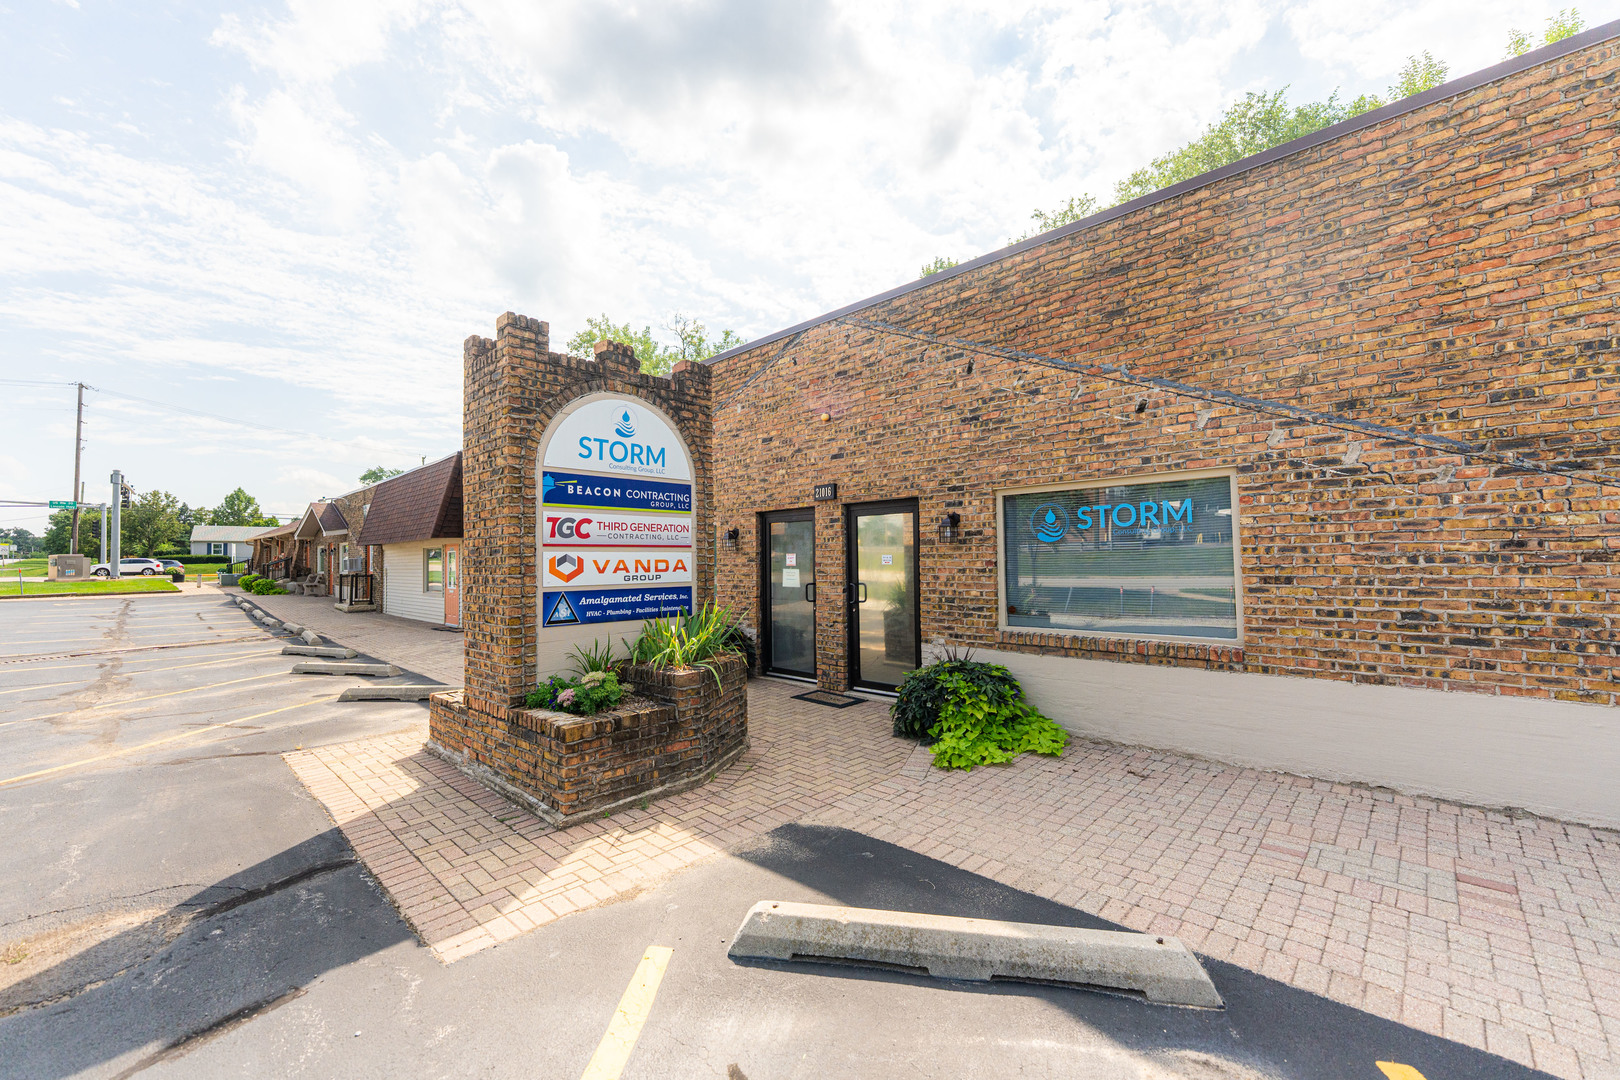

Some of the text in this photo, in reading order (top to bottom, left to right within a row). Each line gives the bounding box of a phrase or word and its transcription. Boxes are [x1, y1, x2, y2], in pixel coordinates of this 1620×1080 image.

[578, 436, 665, 467] STORM
[609, 462, 637, 473] Consulting
[568, 485, 690, 502] BEACON CONTRACTING
[815, 486, 832, 498] 21016
[650, 501, 676, 509] GROUP,
[1077, 498, 1193, 529] STORM
[546, 517, 689, 539] TGC THIRD GENERATION
[1112, 527, 1151, 536] Consulting
[1178, 524, 1193, 532] LLC
[607, 532, 664, 541] CONTRACTING,
[592, 559, 687, 574] VANDA
[623, 574, 662, 582] GROUP
[579, 594, 642, 606] Amalgamated
[644, 592, 678, 601] Services,
[606, 608, 632, 616] Plumbing
[636, 606, 658, 614] Facilities
